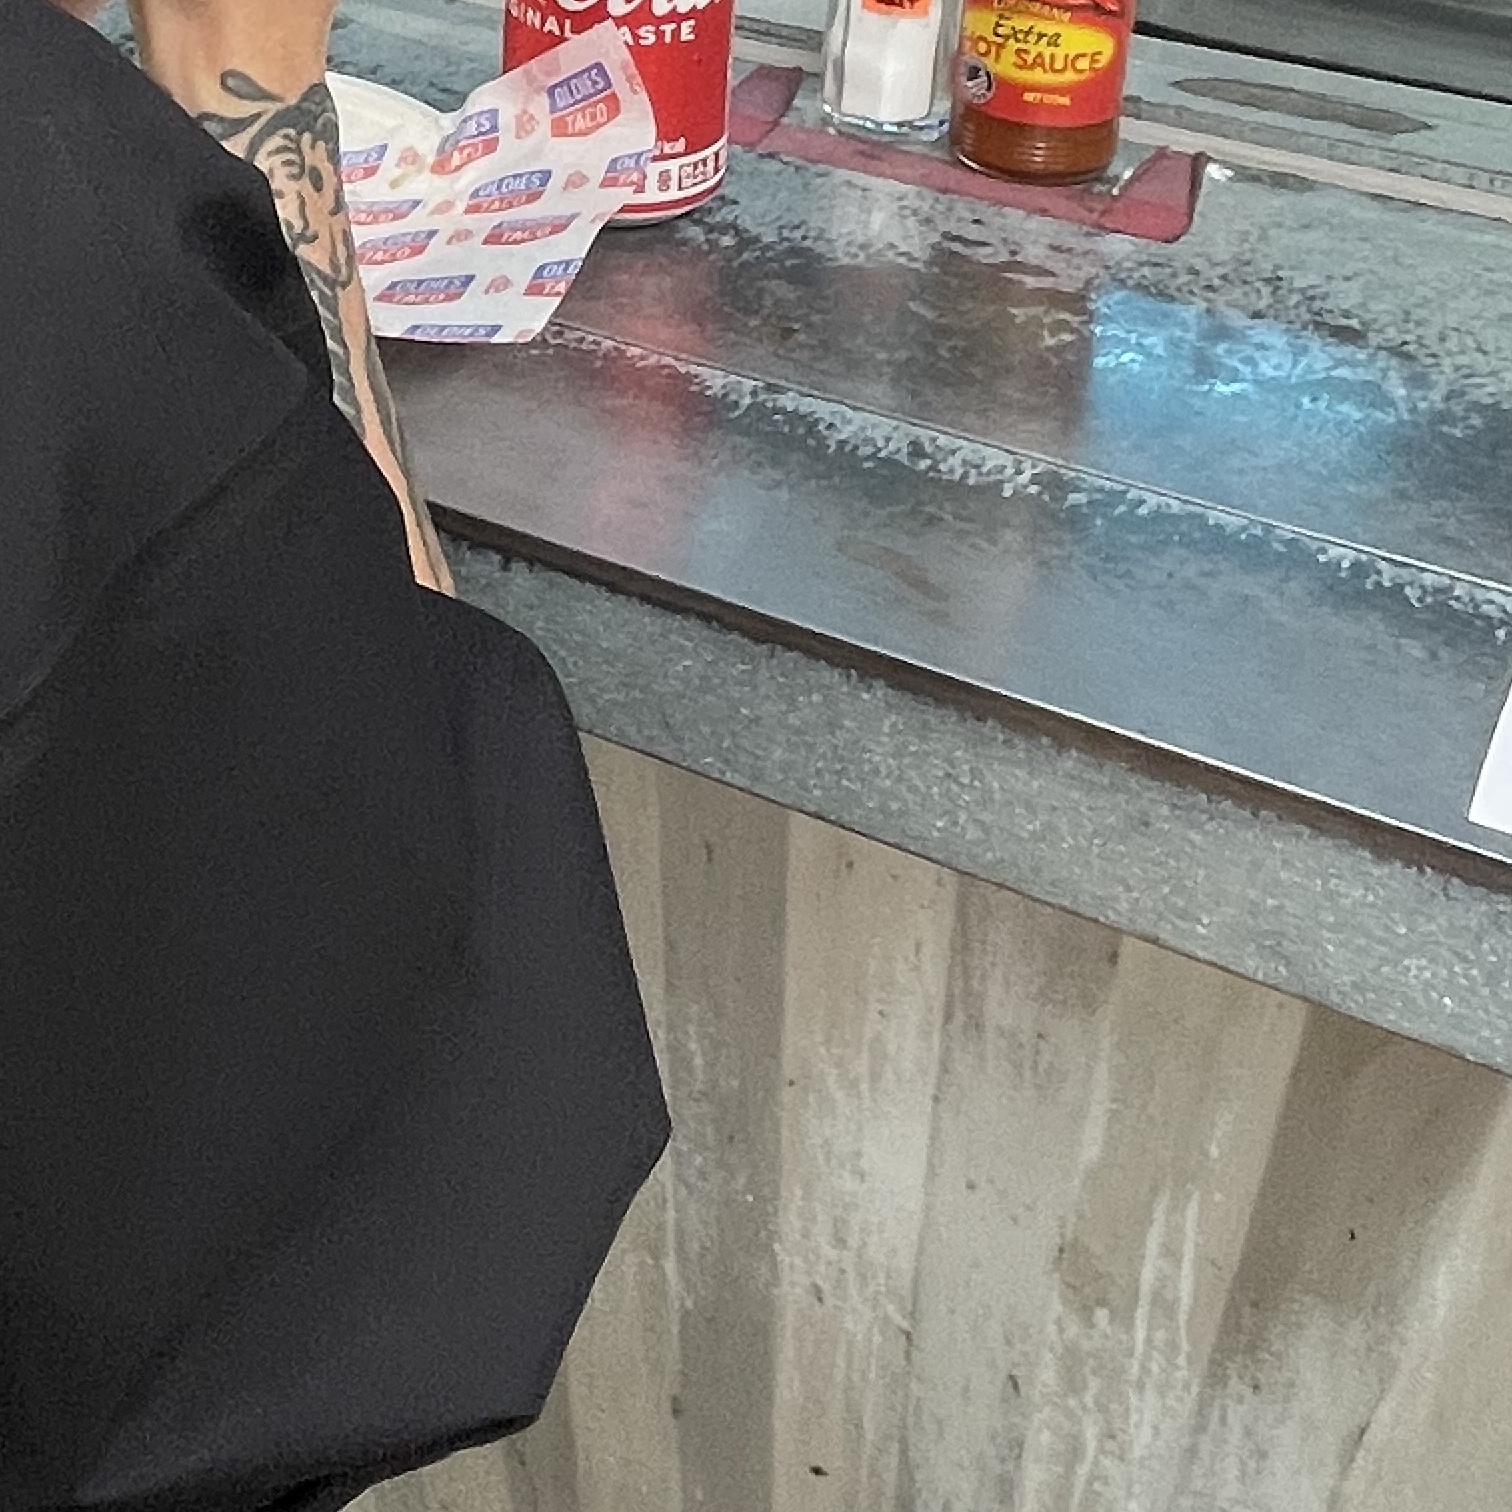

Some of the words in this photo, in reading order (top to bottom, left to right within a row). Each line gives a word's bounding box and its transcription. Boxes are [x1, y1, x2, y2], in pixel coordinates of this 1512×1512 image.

[617, 19, 697, 47] ASTE
[991, 11, 1063, 49] Extra
[1012, 46, 1105, 75] SAUCE
[566, 102, 609, 134] TACO
[543, 261, 583, 278] OLD
[542, 281, 567, 295] TA
